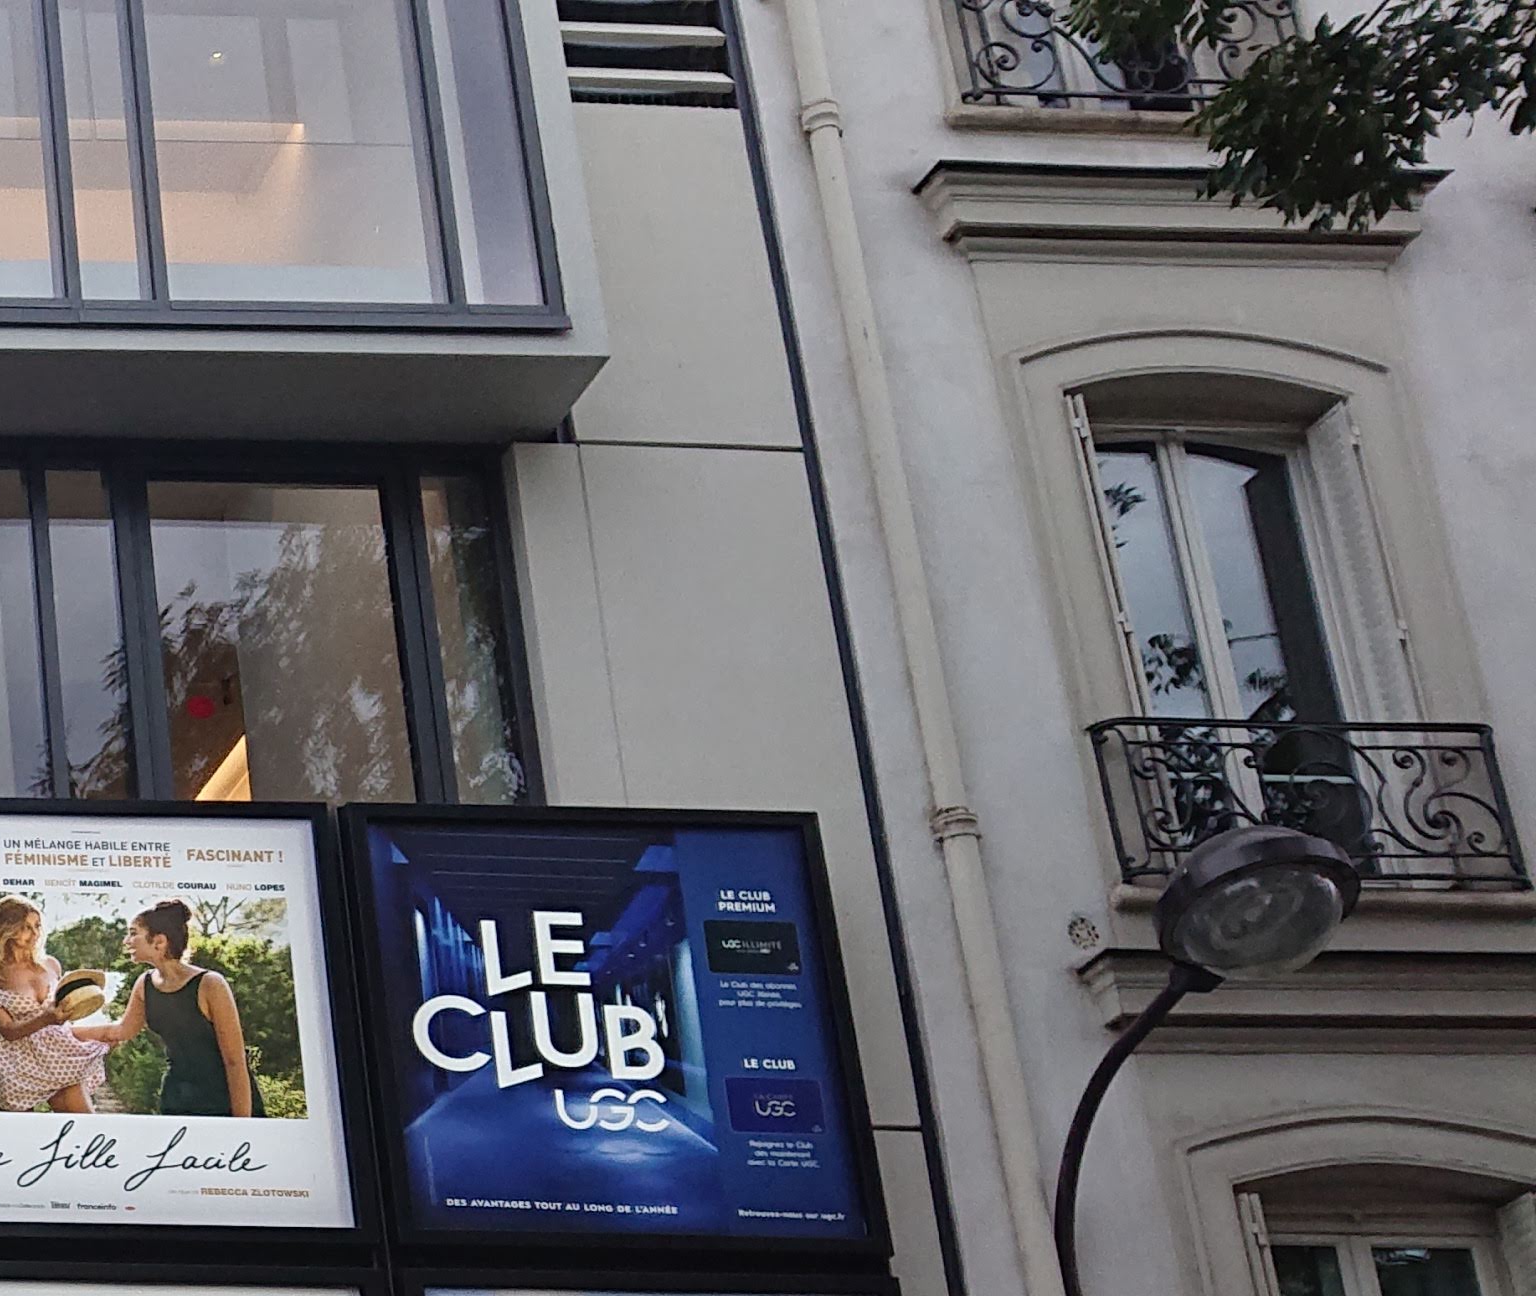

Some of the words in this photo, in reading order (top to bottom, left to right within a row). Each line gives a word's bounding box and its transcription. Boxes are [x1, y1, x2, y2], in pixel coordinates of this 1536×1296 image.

[3, 838, 21, 849] UN
[23, 836, 81, 850] MÉLANGE
[84, 840, 128, 851] HABILE
[131, 841, 171, 852] ENTRE
[4, 850, 88, 867] FÉMINISME
[92, 856, 105, 867] ET
[108, 852, 172, 869] LIBERTÉ
[2, 878, 34, 887] DEHAR
[79, 879, 123, 888] MAGIMEL
[177, 881, 217, 890] COURAU
[254, 883, 285, 892] LOPES
[720, 890, 735, 900] LE
[738, 890, 771, 901] CLUB
[718, 901, 776, 913] PREMIUM
[479, 910, 592, 998] LE
[412, 990, 666, 1090] CLUB
[744, 1058, 758, 1069] LE
[762, 1059, 796, 1070] CLUB
[554, 1088, 671, 1132] UGC
[754, 1100, 797, 1117] UGC
[17, 1120, 119, 1188] fille
[123, 1126, 267, 1192] facile
